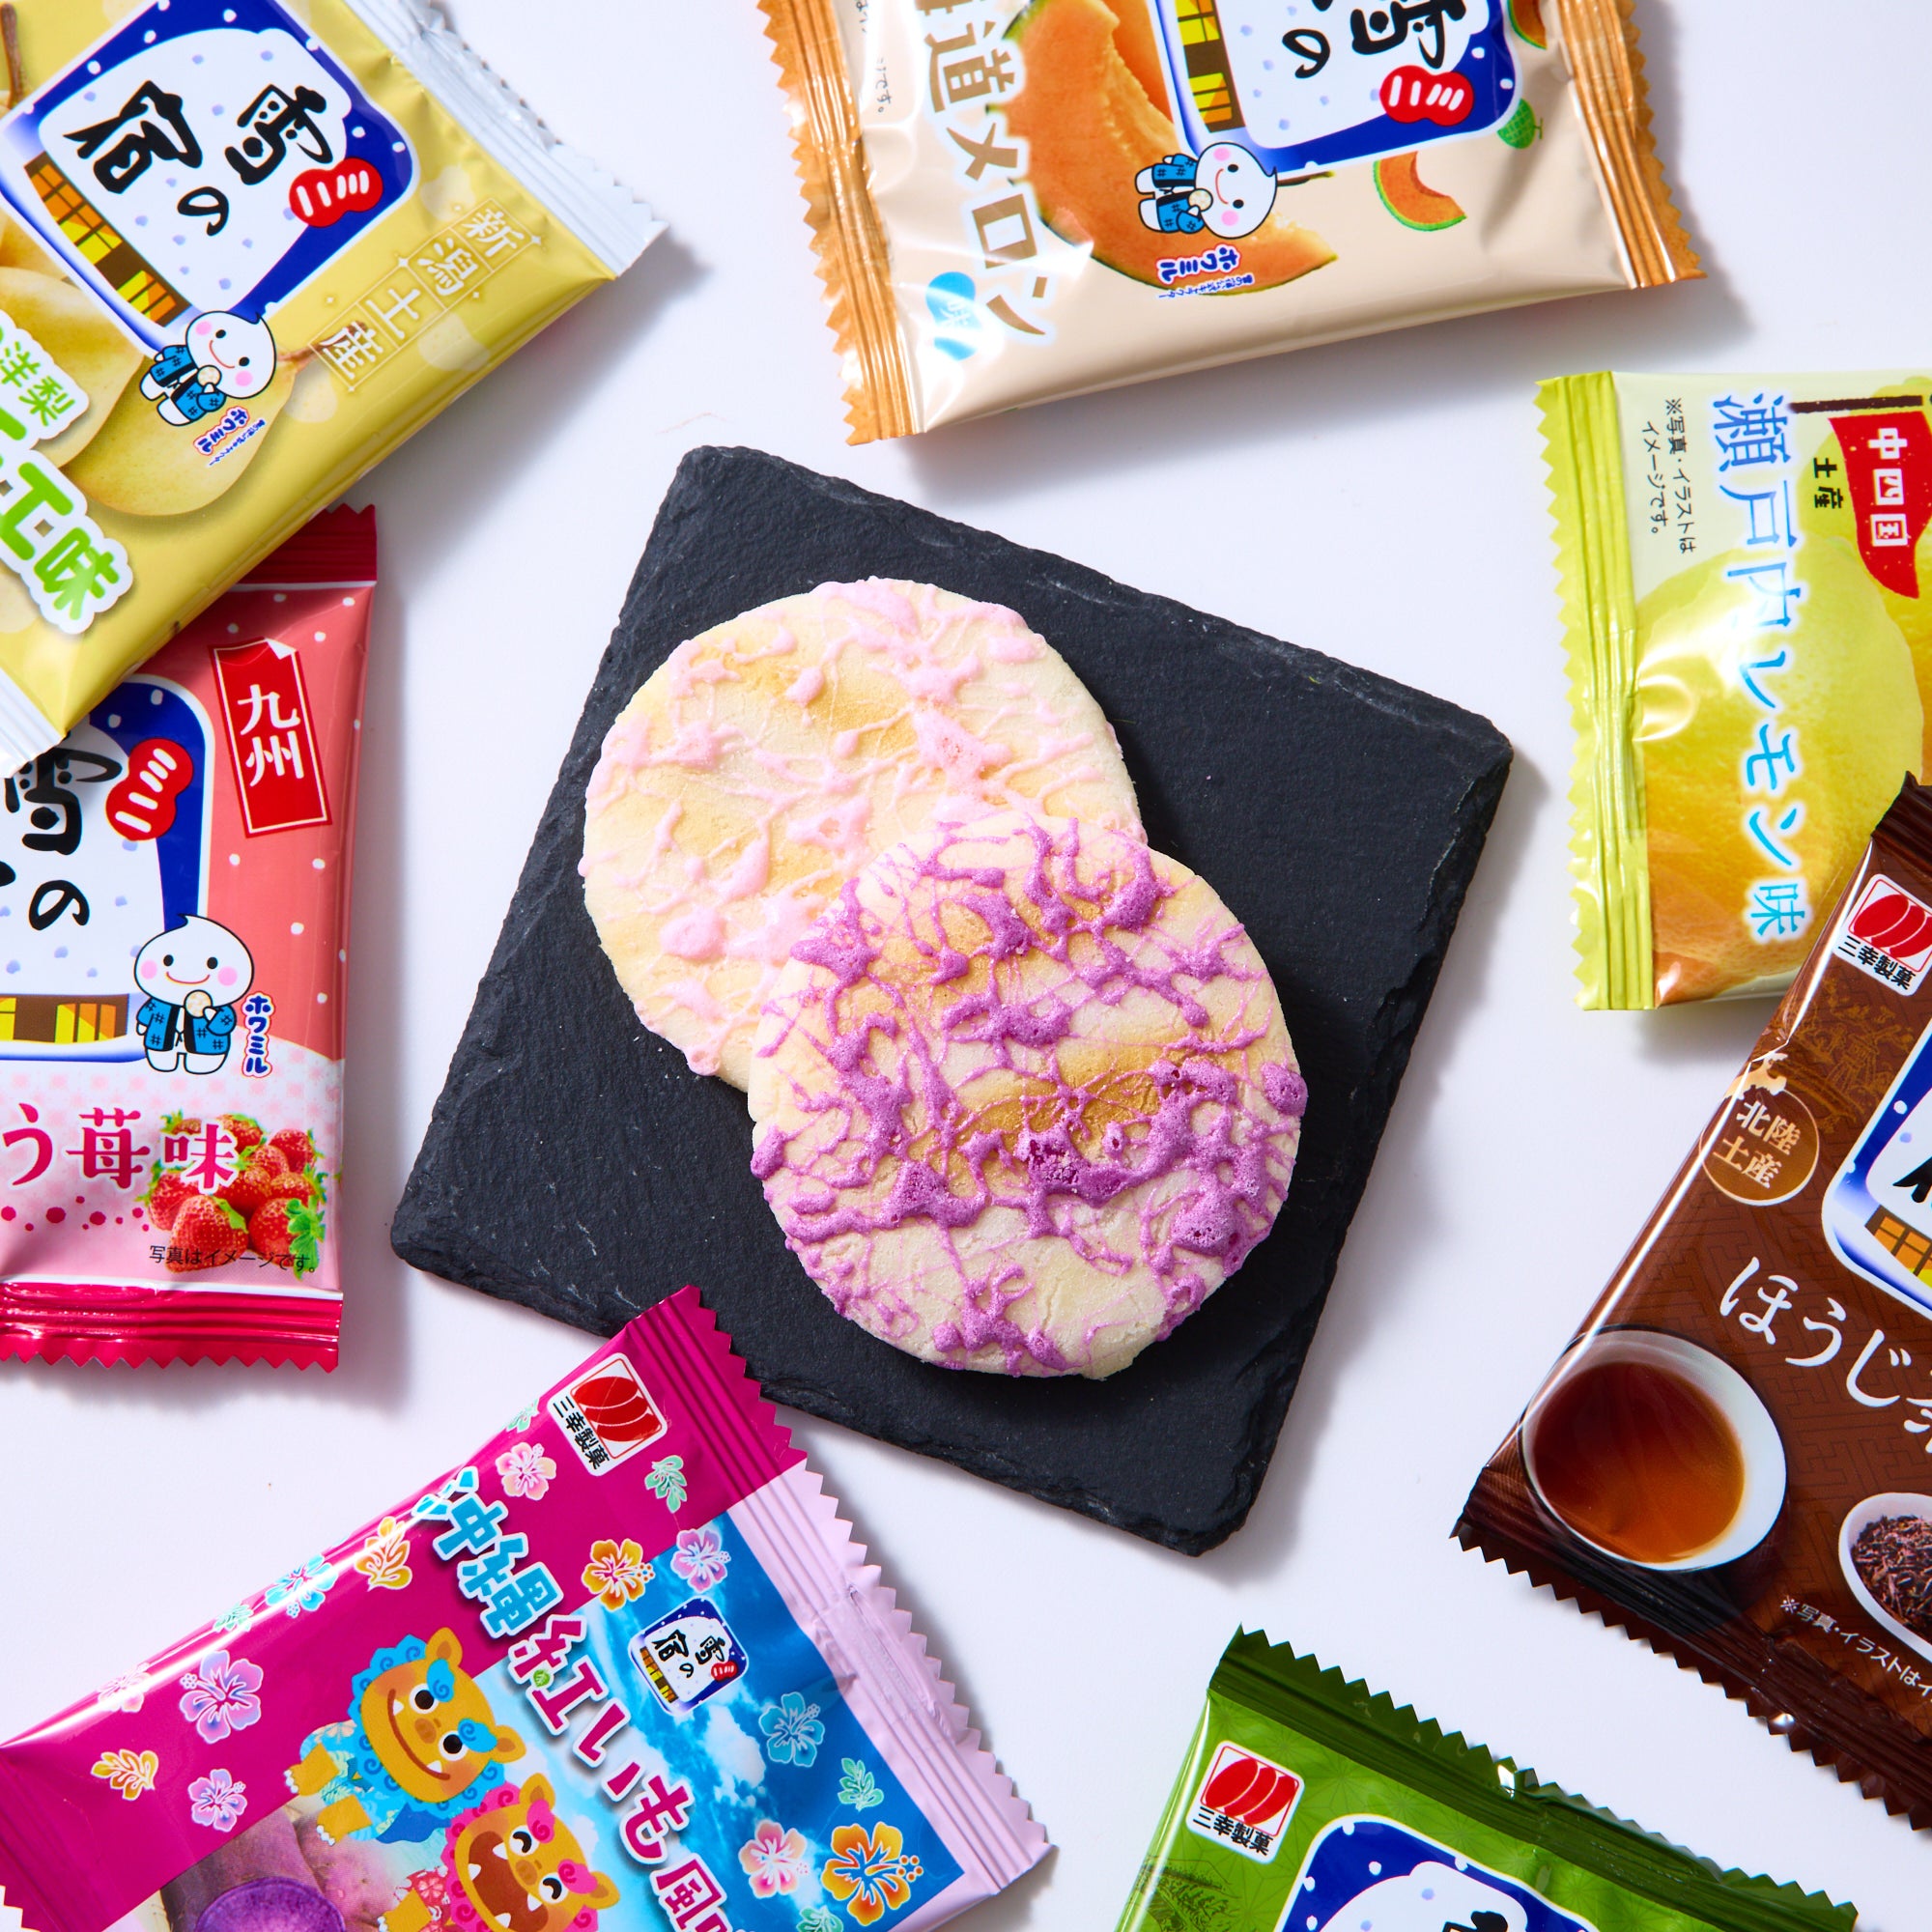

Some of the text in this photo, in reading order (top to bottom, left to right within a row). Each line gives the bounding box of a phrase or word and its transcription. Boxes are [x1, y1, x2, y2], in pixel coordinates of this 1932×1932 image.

[1282, 0, 1466, 78] 雪の
[63, 80, 333, 237] 雪の宿
[915, 0, 1047, 336] 道メロン
[320, 208, 525, 380] 新潟土産
[1159, 246, 1238, 282] ホワミル
[0, 328, 75, 426] 洋梨
[196, 409, 248, 453] ホワミル
[1641, 421, 1668, 534] イメージです。
[1665, 397, 1696, 554] ※写真・イラストは
[1813, 457, 1844, 509] 土産
[1868, 427, 1910, 547] 中四国
[1713, 393, 1805, 937] 瀬戸内レモン味
[239, 683, 305, 788] 九州
[0, 731, 123, 930] 雪の
[1837, 935, 1917, 991] 三幸製菓
[245, 995, 271, 1074] ホワミル
[2, 1102, 238, 1189] う苺味
[1713, 1135, 1782, 1189] 土産
[1736, 1100, 1801, 1155] 北陸
[149, 1243, 316, 1274] 写真はイメージです。
[553, 1395, 611, 1470] 三幸製菓
[651, 1629, 726, 1679] 雪の宿
[1780, 1595, 1932, 1703] ※写真・イラストはイ
[414, 1469, 730, 1932] 沖縄紅いも風
[1192, 1805, 1274, 1857] 三幸製菓
